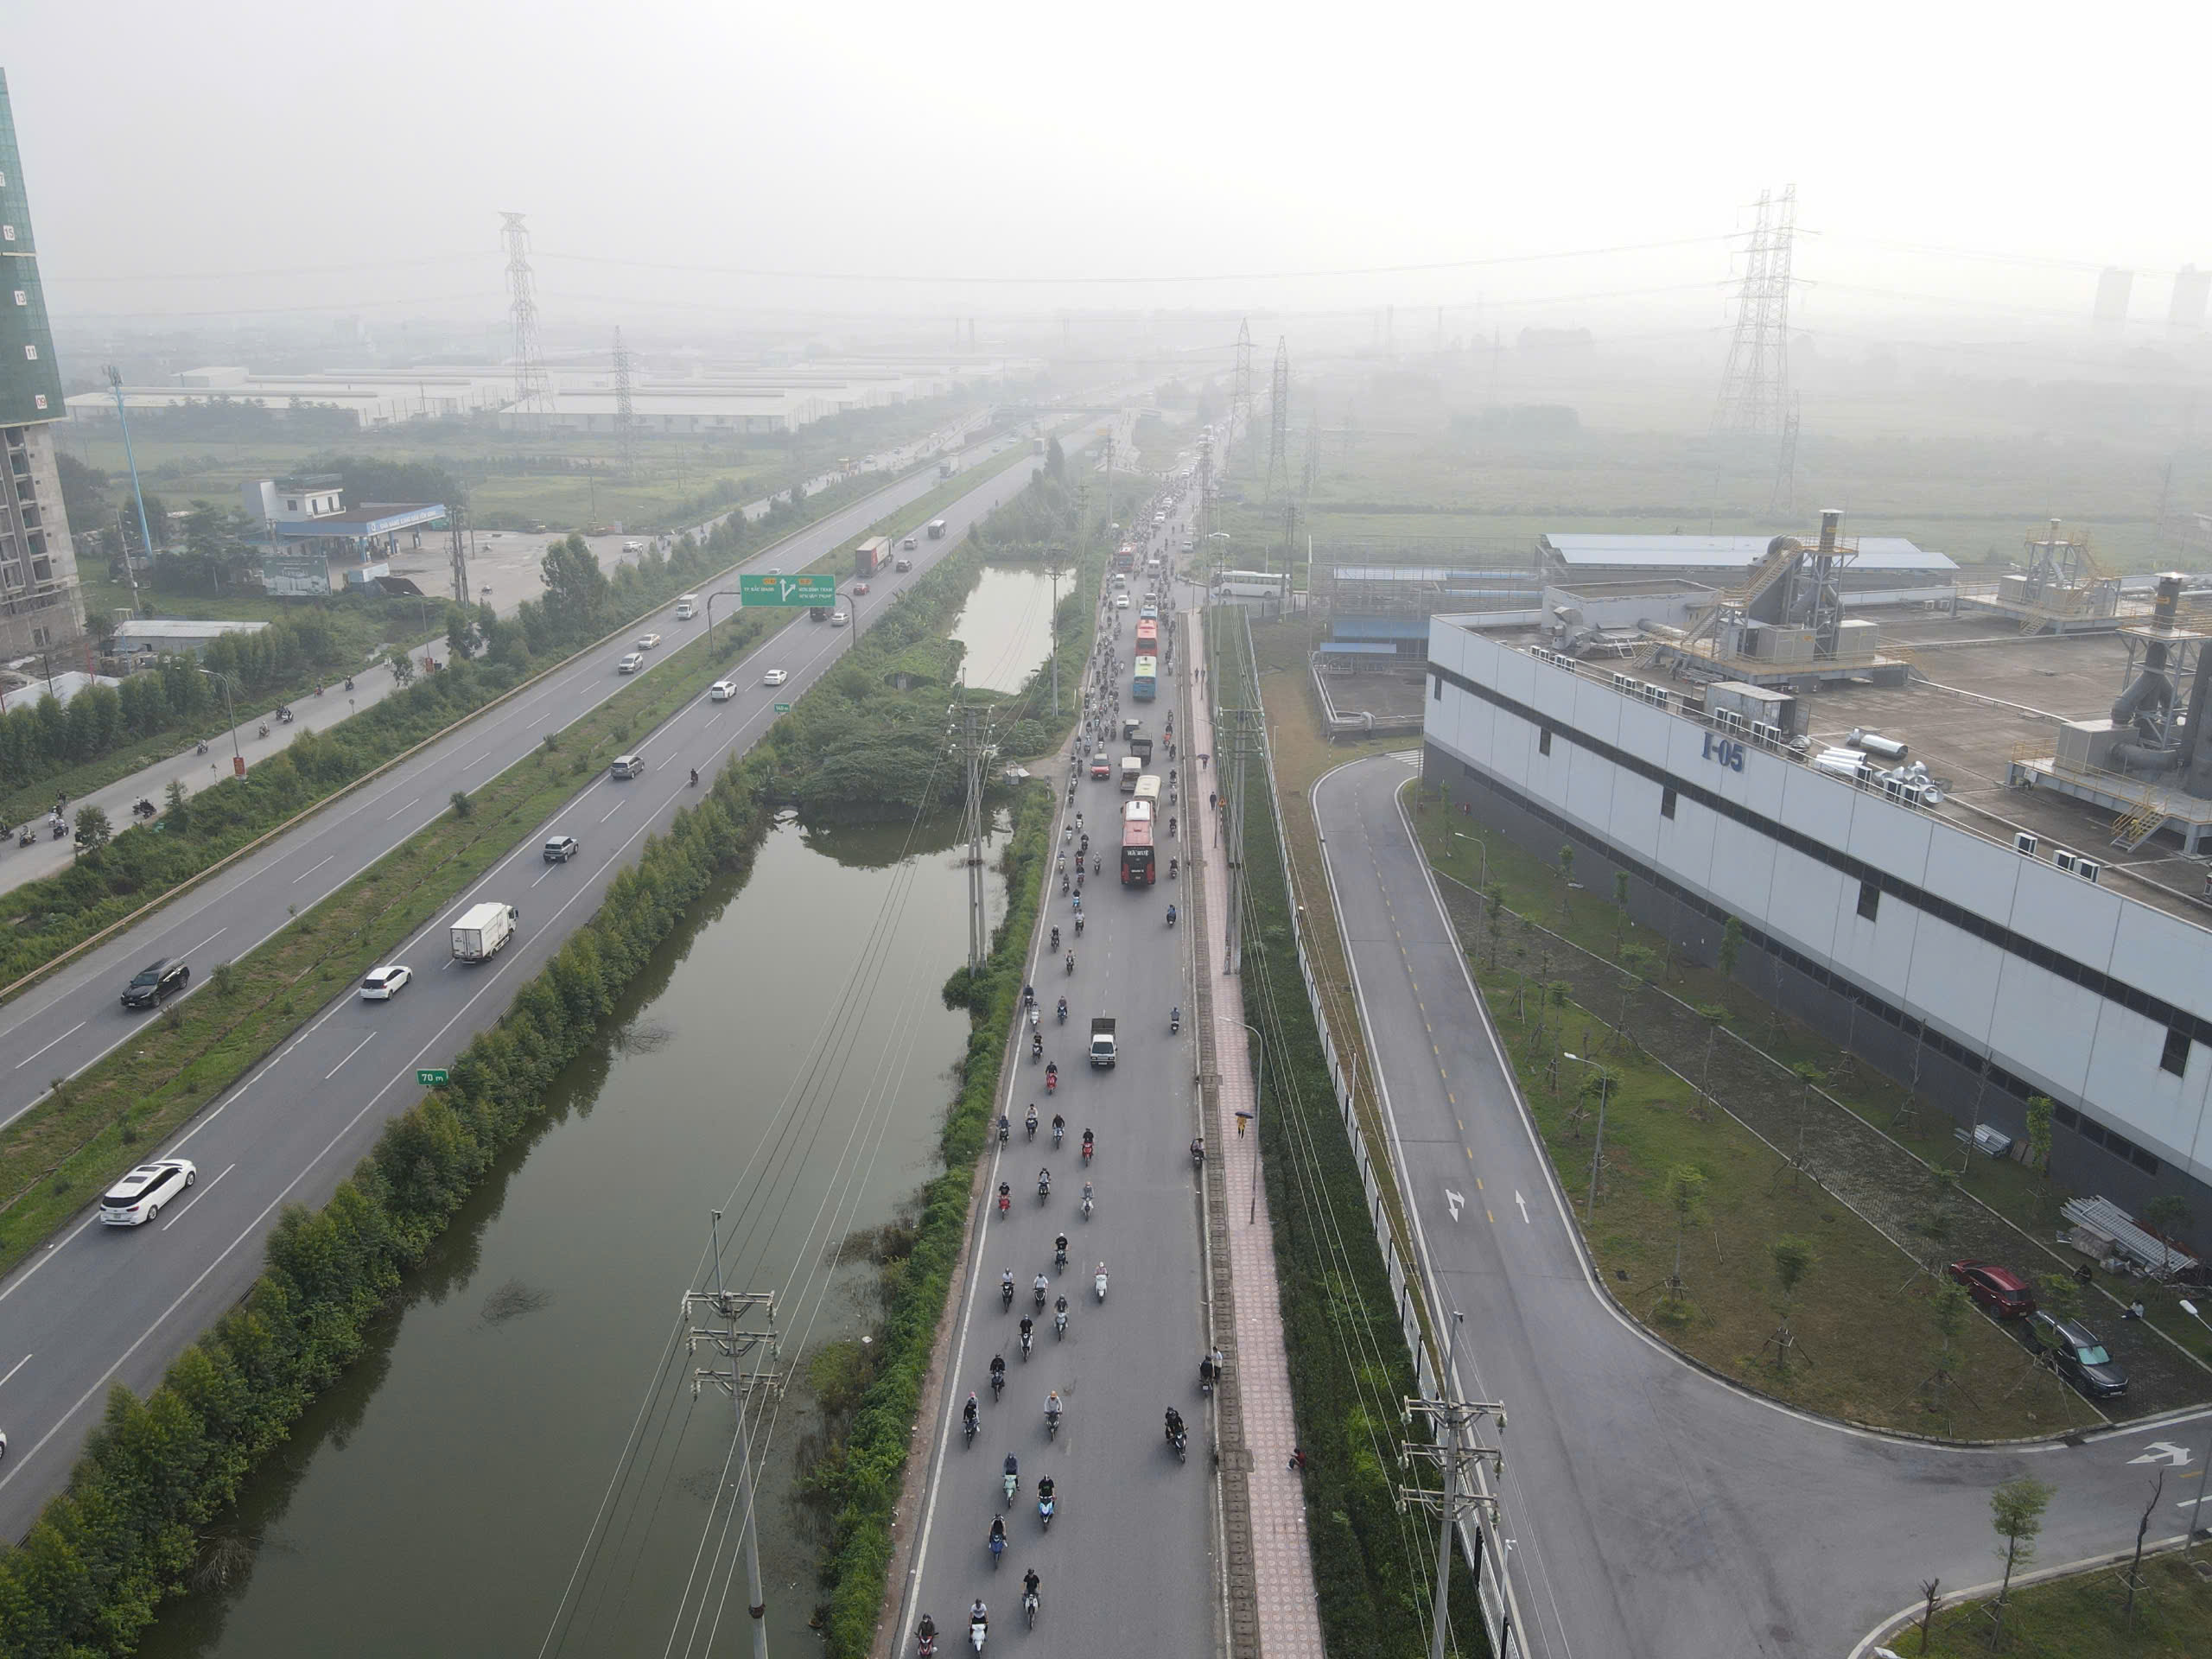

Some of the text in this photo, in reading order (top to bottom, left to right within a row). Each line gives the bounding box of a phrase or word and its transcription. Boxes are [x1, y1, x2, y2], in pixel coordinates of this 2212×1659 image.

[4, 227, 14, 238] 15
[17, 293, 26, 303] 13
[28, 348, 35, 358] 11
[37, 398, 46, 407] 09
[1702, 732, 1743, 772] I-05
[422, 1073, 433, 1082] 70
